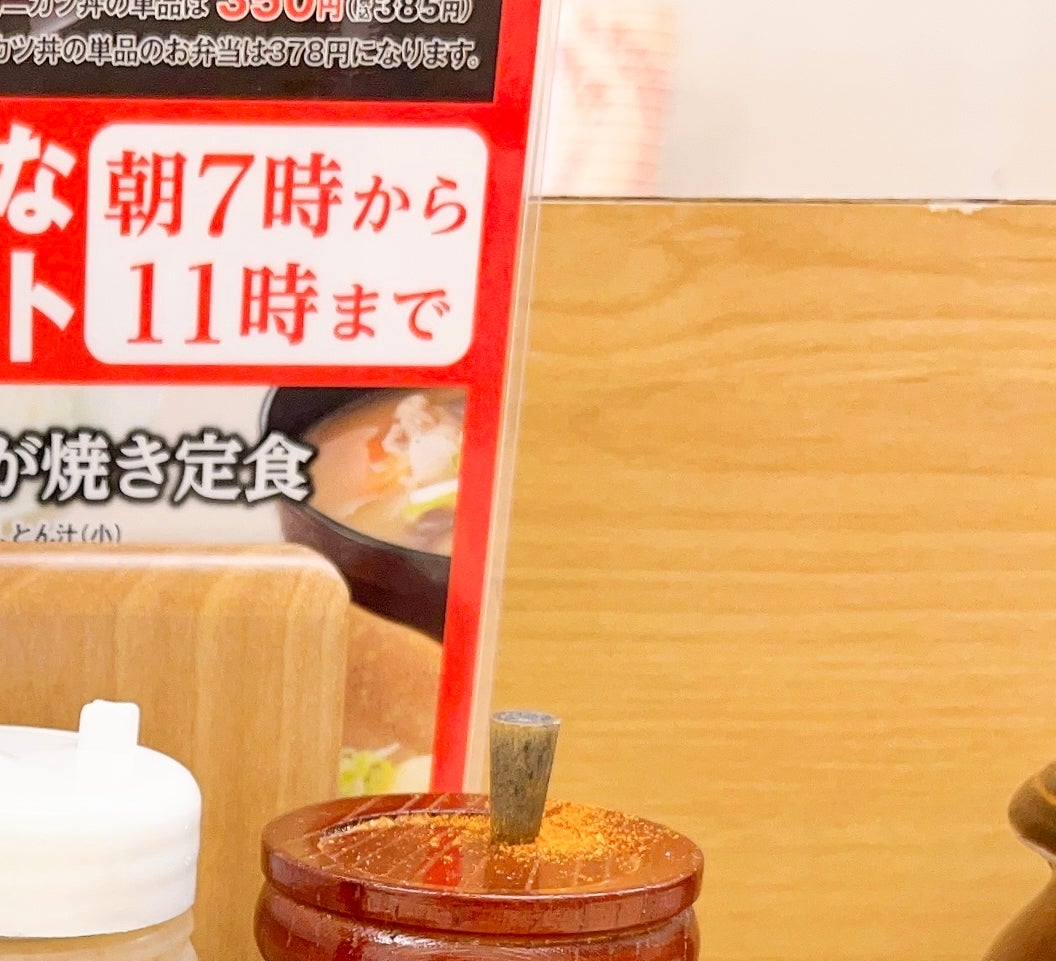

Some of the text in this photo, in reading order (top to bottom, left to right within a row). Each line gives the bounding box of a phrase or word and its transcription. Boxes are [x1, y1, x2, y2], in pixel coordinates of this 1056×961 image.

[104, 150, 468, 239] 朝7時から
[126, 262, 451, 347] 11時まで
